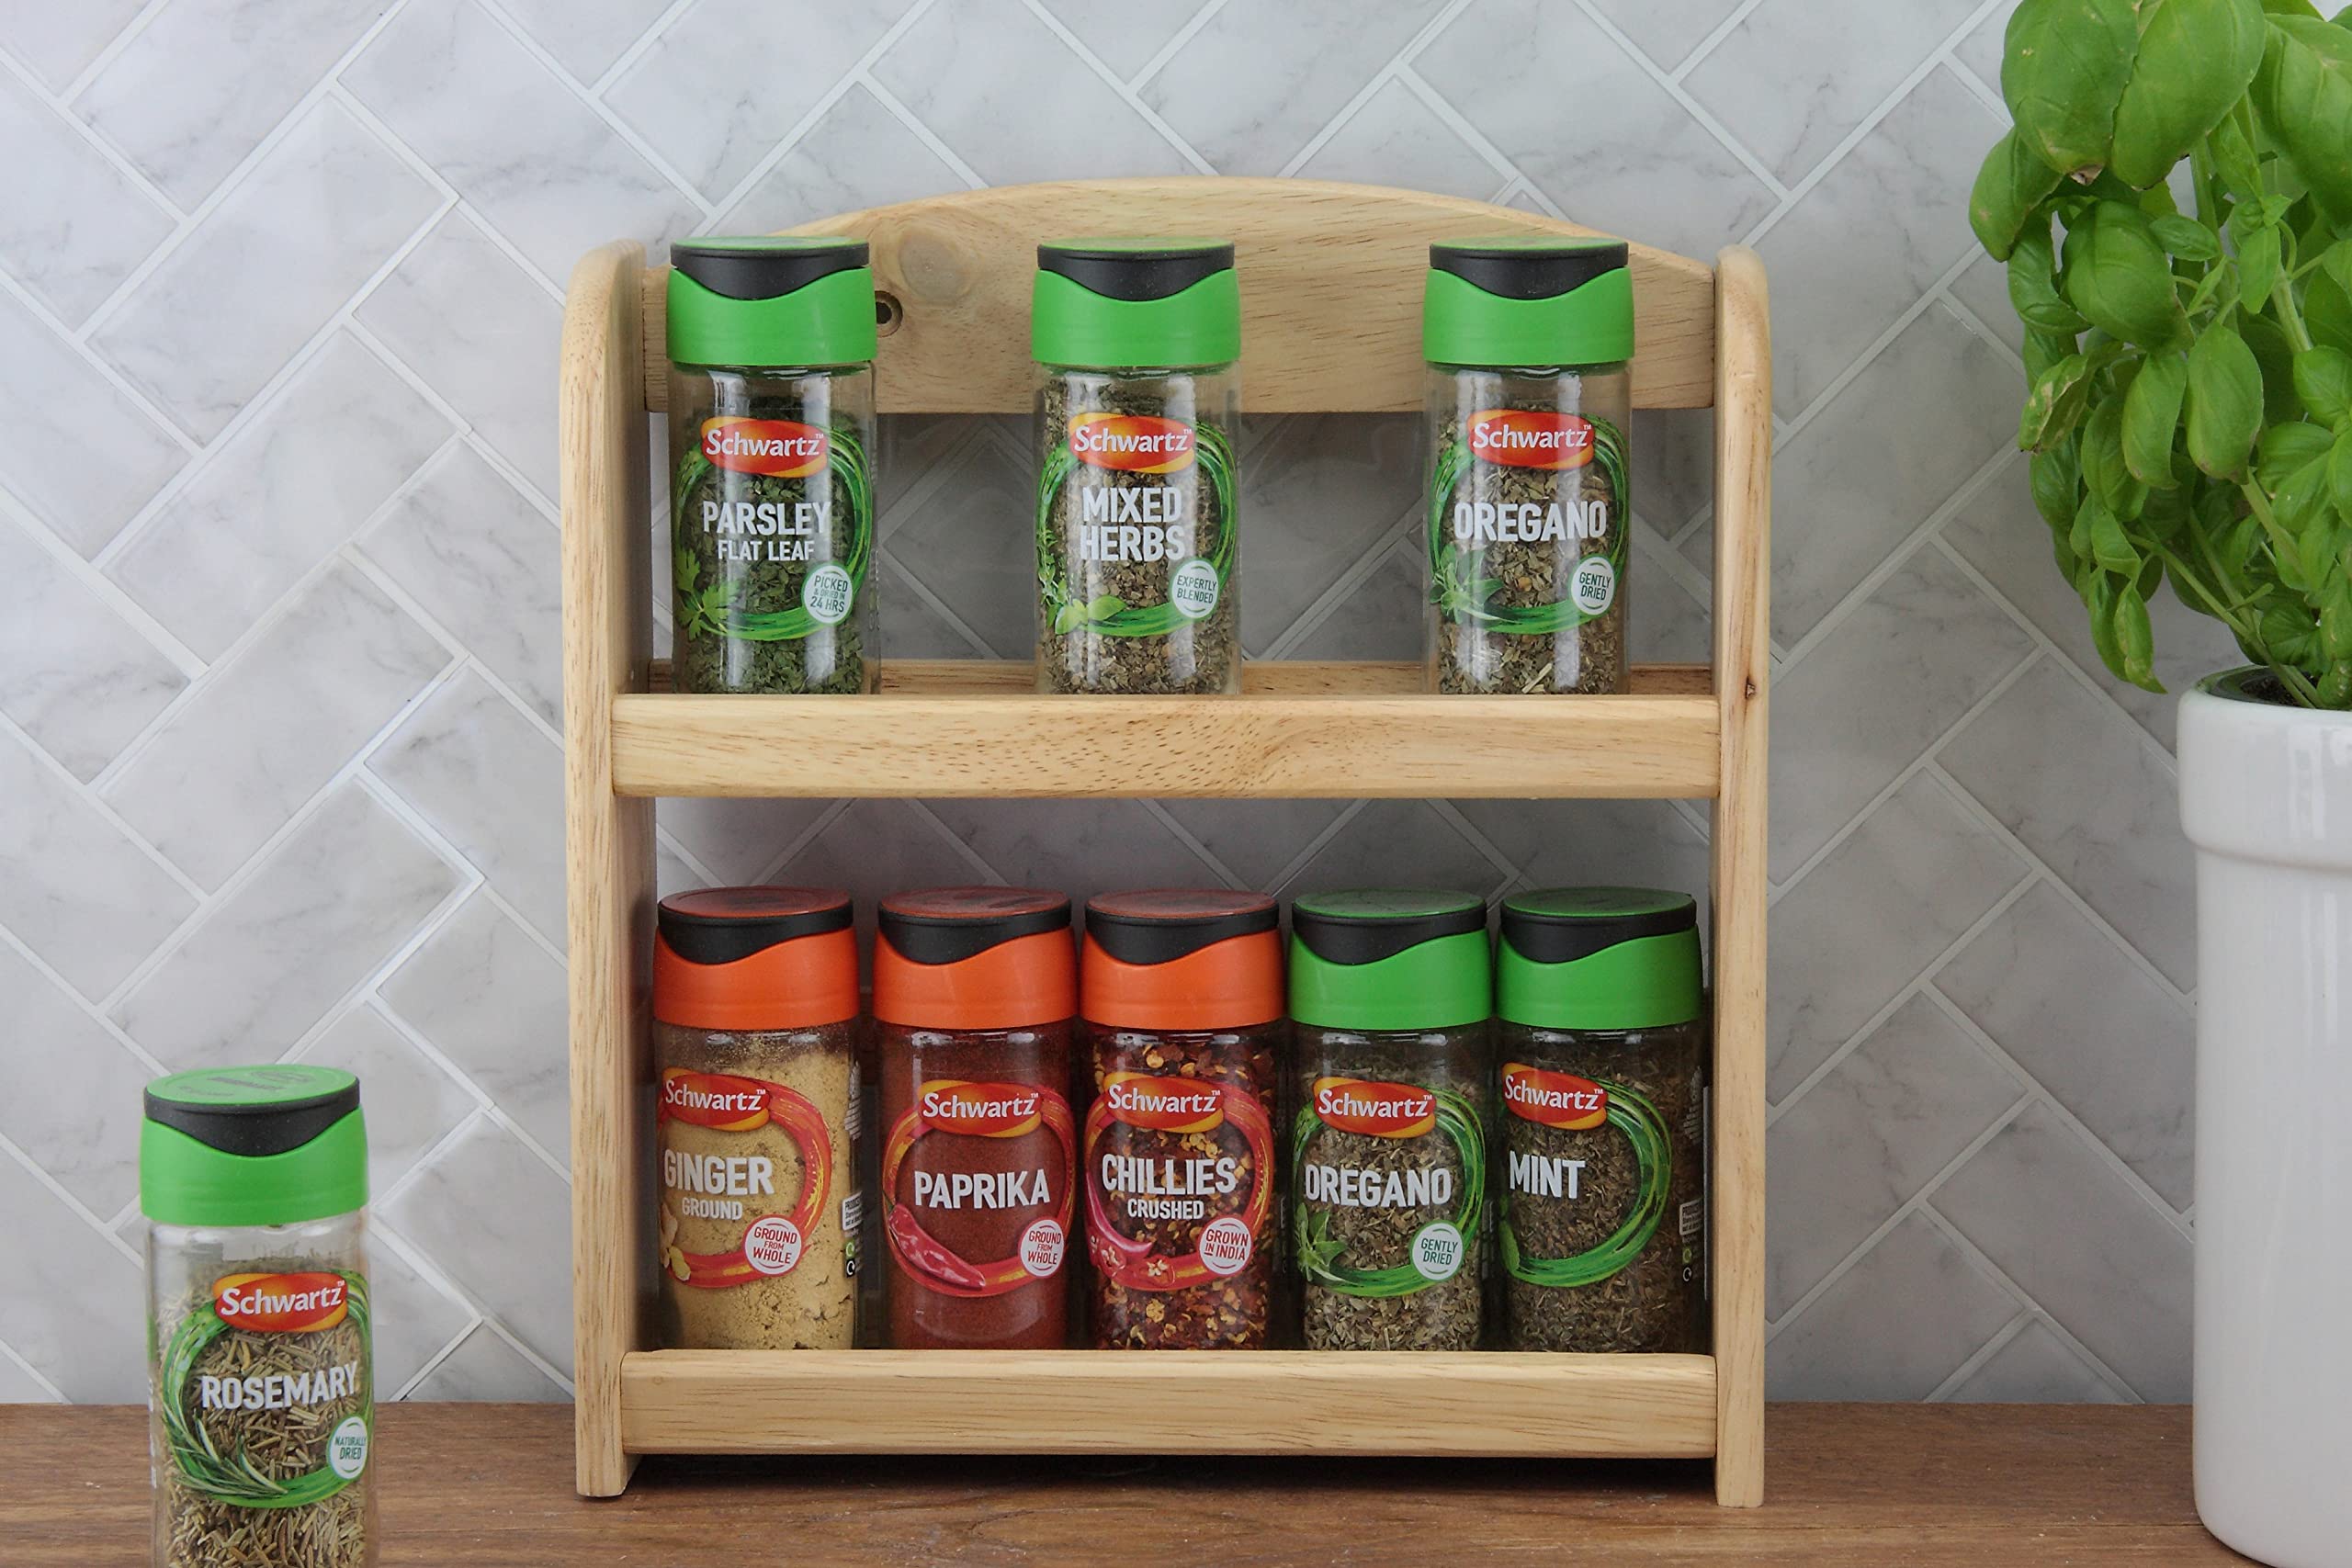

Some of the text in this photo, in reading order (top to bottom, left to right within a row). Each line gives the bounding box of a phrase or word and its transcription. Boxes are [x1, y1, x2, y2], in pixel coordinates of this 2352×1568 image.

[1082, 486, 1182, 523] MIXED
[703, 501, 831, 536] PARSLEY
[1453, 501, 1607, 542] OREGANO
[718, 540, 815, 561] FLAT LEAF
[1080, 525, 1184, 562] HERBS
[814, 575, 848, 592] PICKED
[1177, 574, 1216, 592] EXPERTLY
[1579, 571, 1611, 589] GENTLY
[1177, 589, 1214, 604] BLENDED
[1580, 585, 1606, 601] DRIED
[810, 595, 845, 613] 24 HRS
[664, 1148, 775, 1196] GINGER
[1102, 1154, 1237, 1195] CHILLIES
[1509, 1150, 1586, 1199] MINT
[914, 1168, 1051, 1209] PAPRIKA
[1305, 1164, 1452, 1208] OREGANO
[682, 1198, 743, 1221] GROUND
[1127, 1198, 1204, 1220] CRUSHED
[753, 1226, 797, 1245] GROUND
[1028, 1230, 1061, 1245] GROUND
[1205, 1229, 1249, 1247] GROWN
[763, 1241, 785, 1250] FROM
[1037, 1244, 1052, 1252] FROM
[1204, 1242, 1246, 1261] IN INDIA
[1420, 1237, 1458, 1254] GENTLY
[752, 1247, 792, 1265] WHOLE
[1028, 1251, 1057, 1265] WHOLE
[1423, 1250, 1453, 1265] DRIED
[199, 1360, 357, 1410] ROSEMARY
[339, 1447, 362, 1461] DRIED
